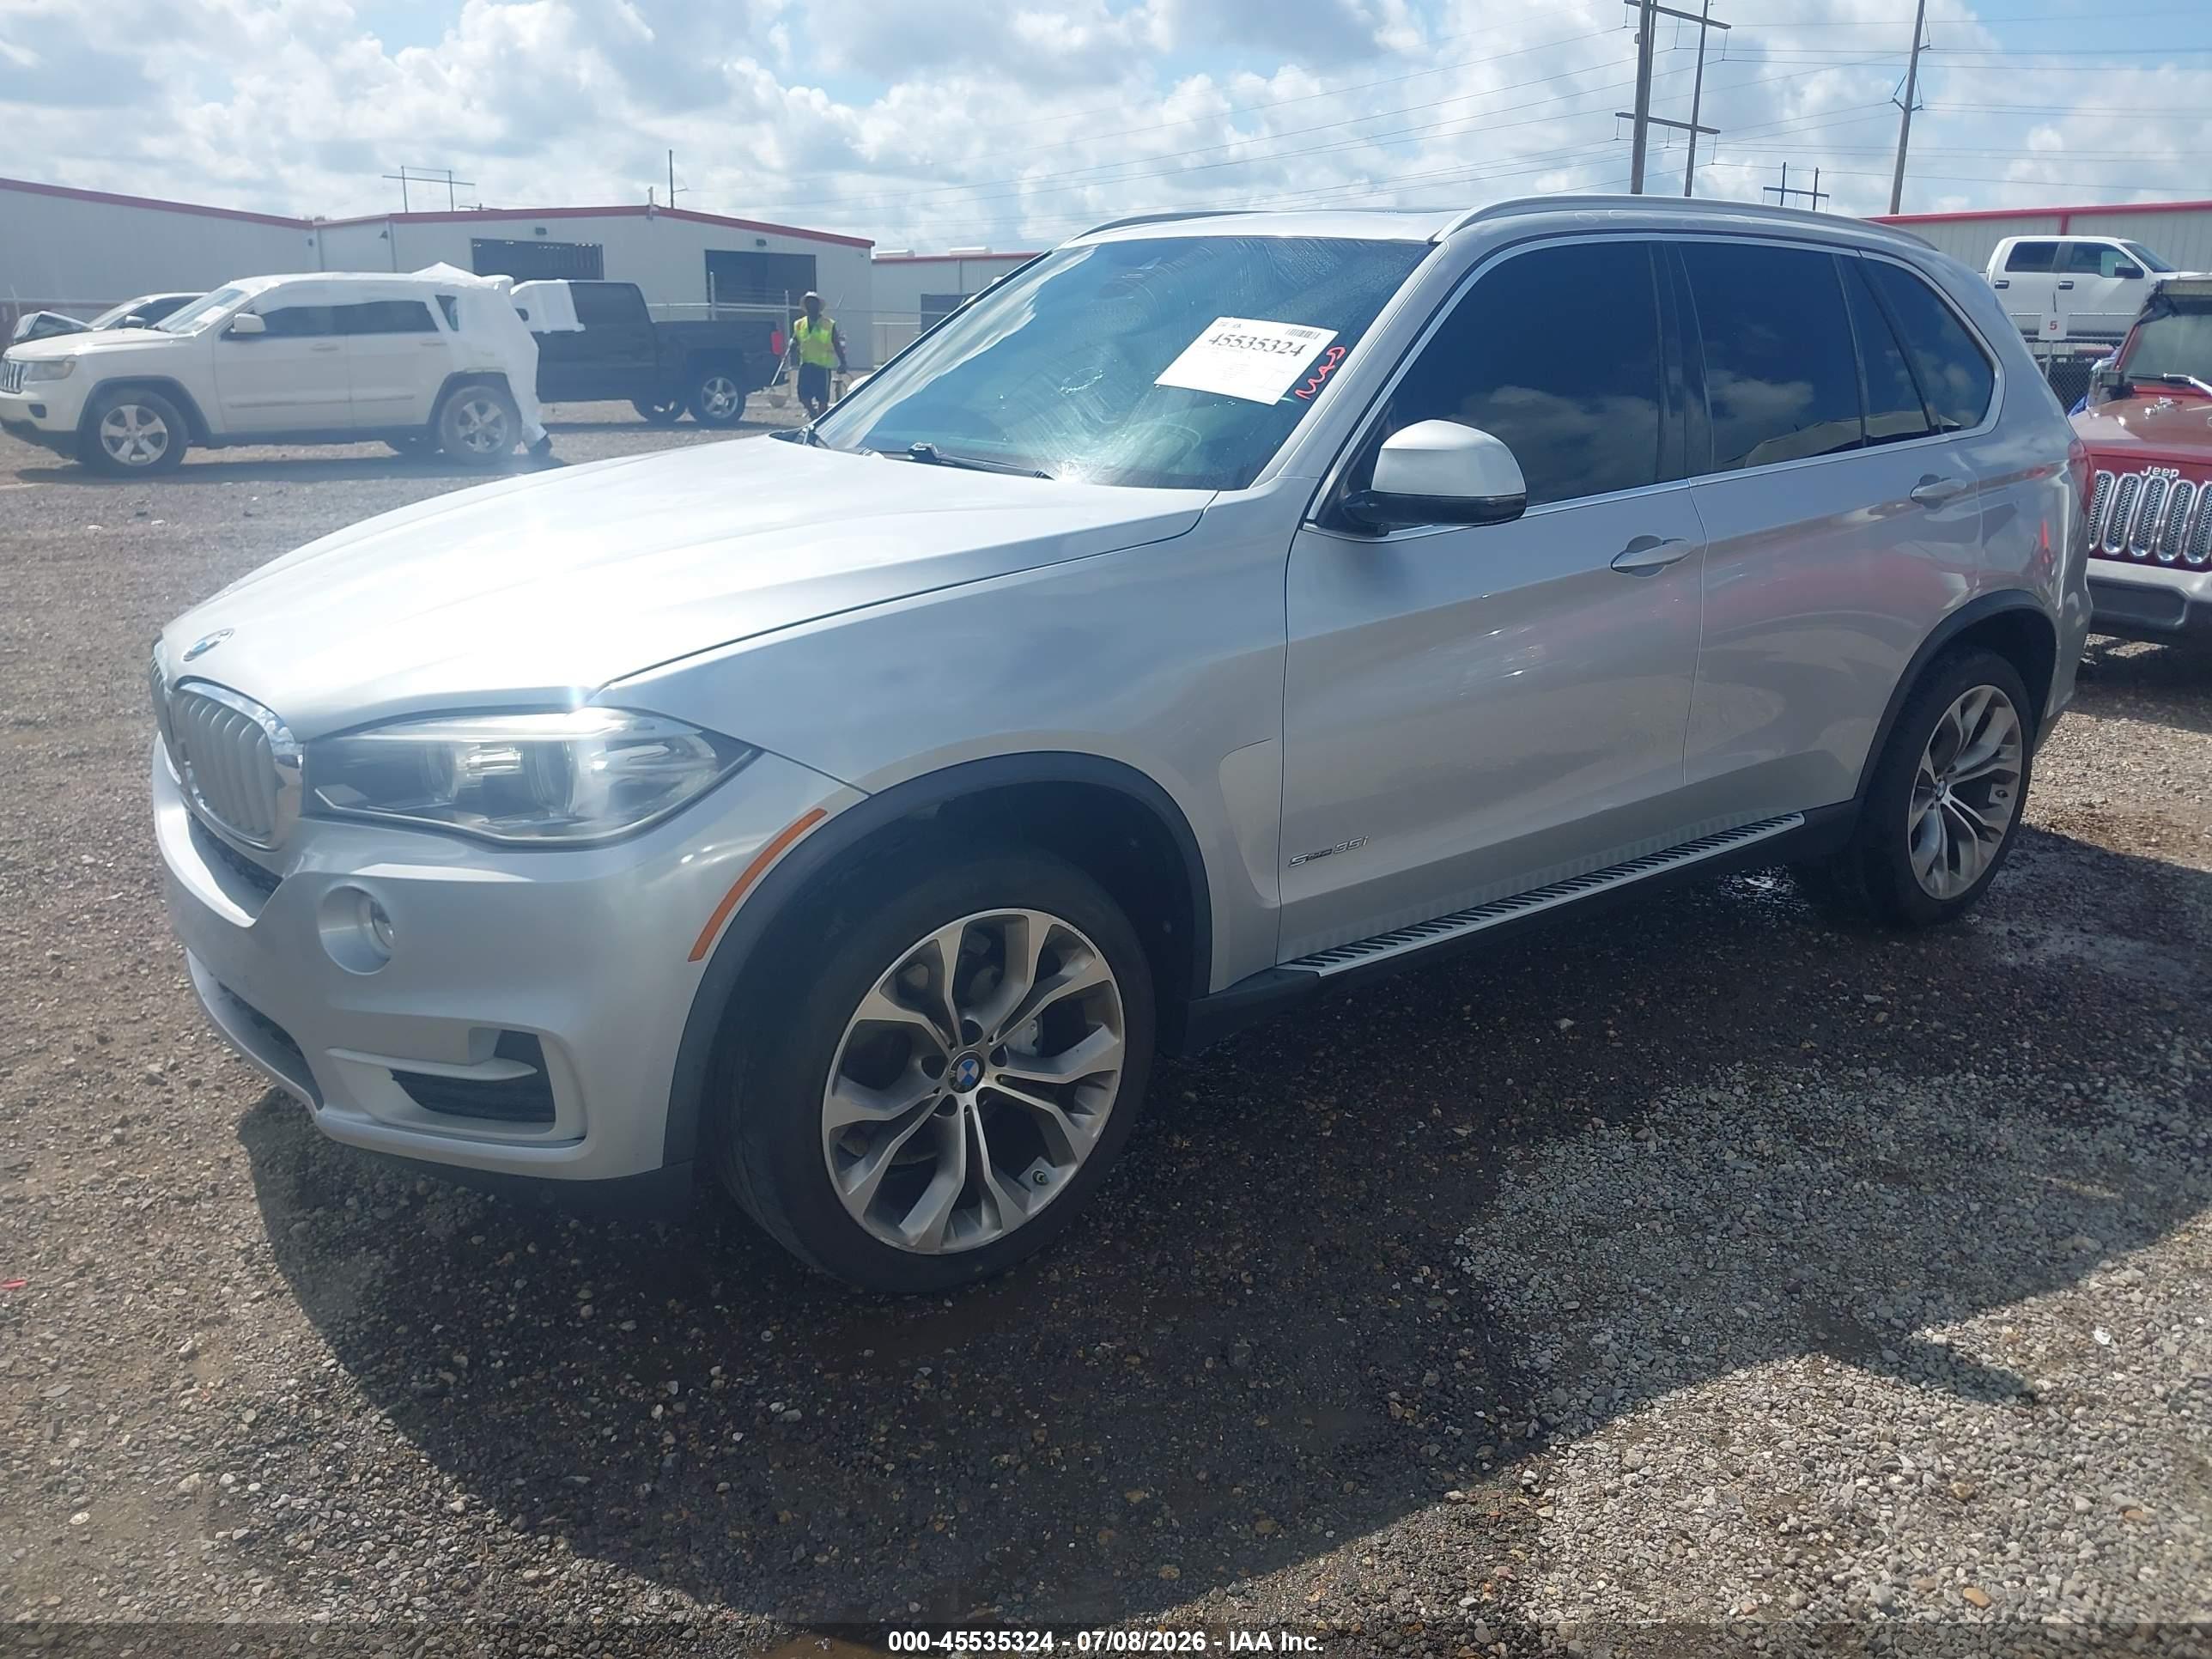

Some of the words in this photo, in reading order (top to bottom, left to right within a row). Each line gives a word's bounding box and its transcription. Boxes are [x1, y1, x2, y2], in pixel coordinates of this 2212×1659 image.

[2049, 320, 2057, 331] 5
[1208, 332, 1307, 357] 45535324
[2140, 465, 2180, 479] Jeep
